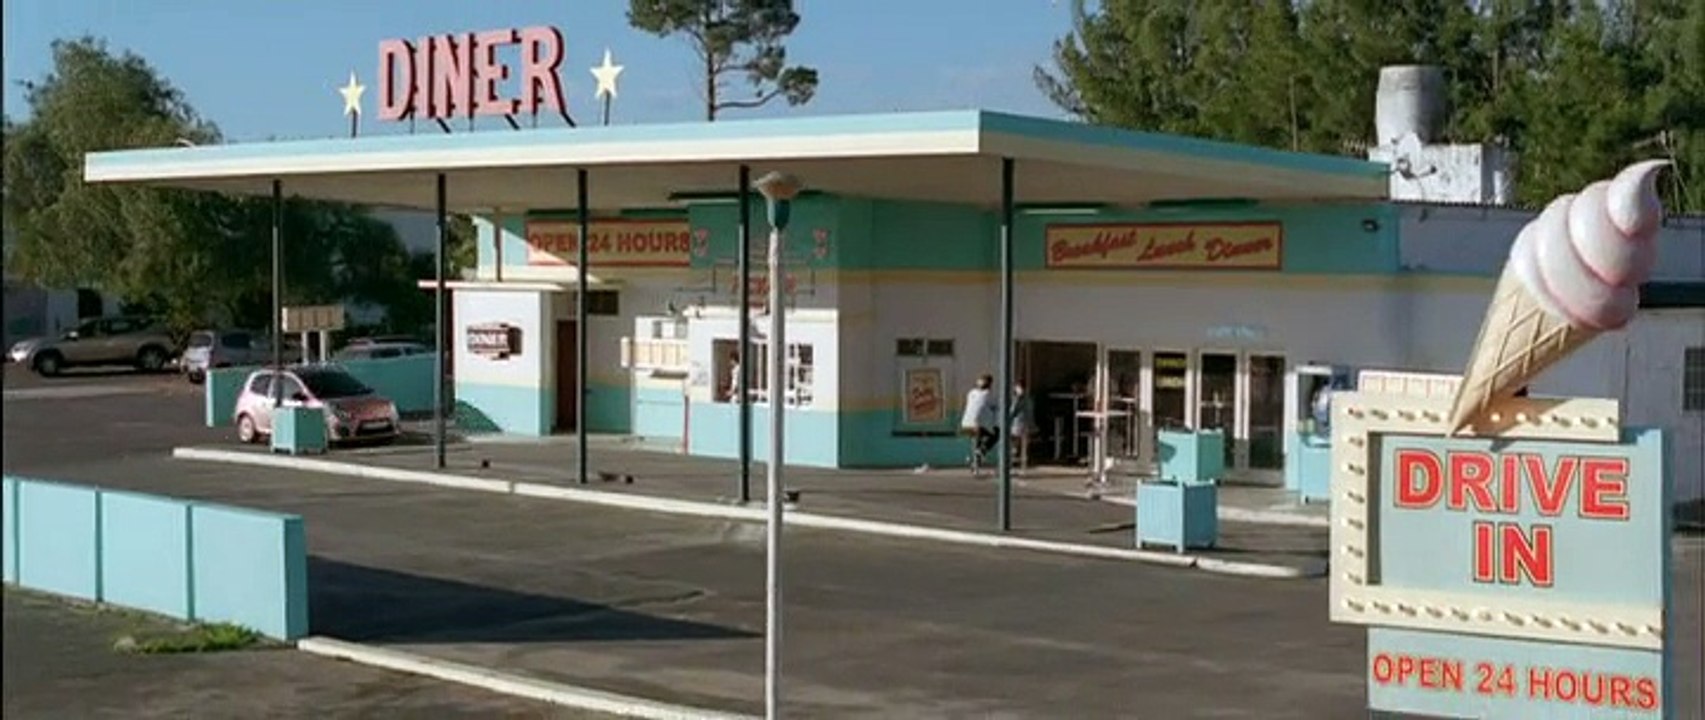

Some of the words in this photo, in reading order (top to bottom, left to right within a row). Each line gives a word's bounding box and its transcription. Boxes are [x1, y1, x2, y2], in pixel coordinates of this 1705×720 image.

[378, 26, 567, 121] DINER
[528, 233, 580, 252] OPEN
[587, 233, 611, 252] 24
[617, 231, 690, 252] HOURS
[1052, 229, 1138, 262] Breakfast
[1137, 230, 1196, 262] Lunch
[1204, 236, 1273, 261] Dinner
[1394, 449, 1630, 520] DRIVE
[1473, 520, 1553, 587] IN
[1373, 653, 1463, 690] OPEN
[1477, 663, 1517, 695] 24
[1529, 667, 1657, 709] HOURS
